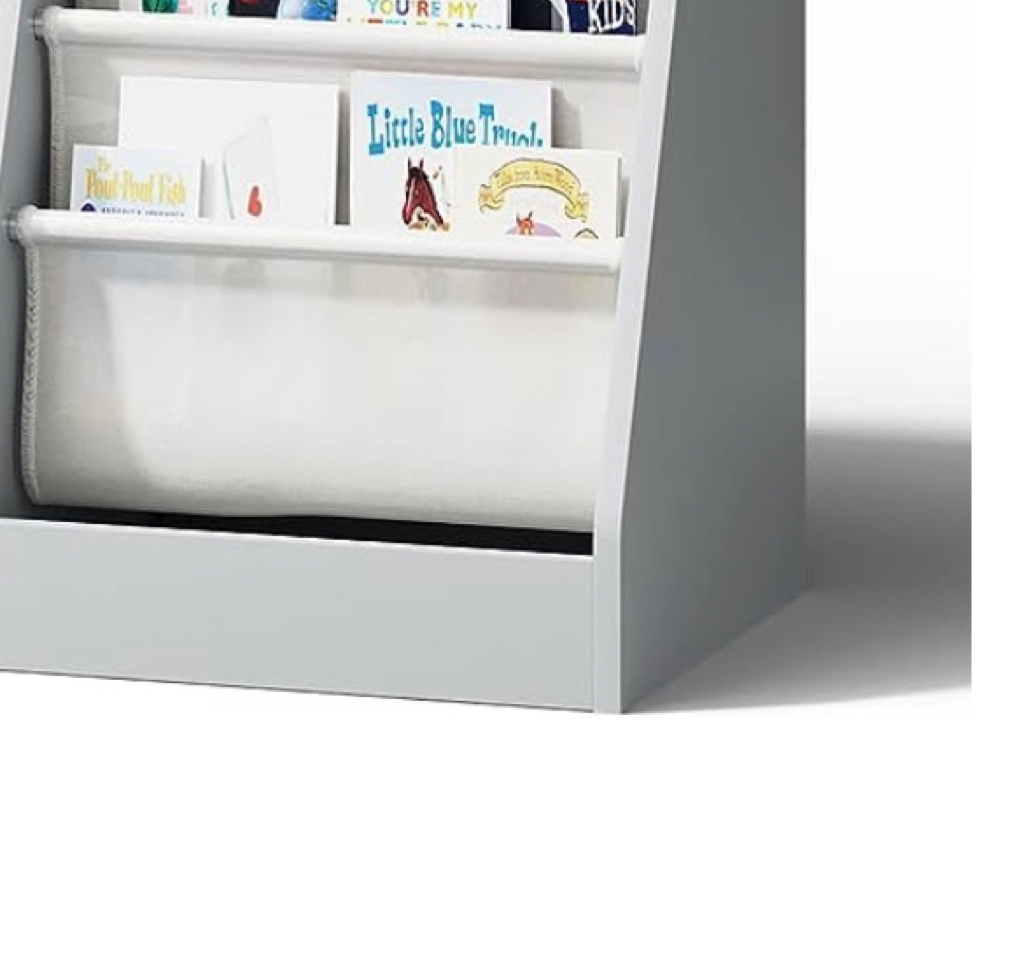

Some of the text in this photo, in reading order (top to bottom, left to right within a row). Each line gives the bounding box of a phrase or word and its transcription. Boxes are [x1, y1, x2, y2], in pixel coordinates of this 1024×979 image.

[448, 1, 478, 20] MY
[367, 104, 425, 155] Little
[430, 99, 476, 149] Blue
